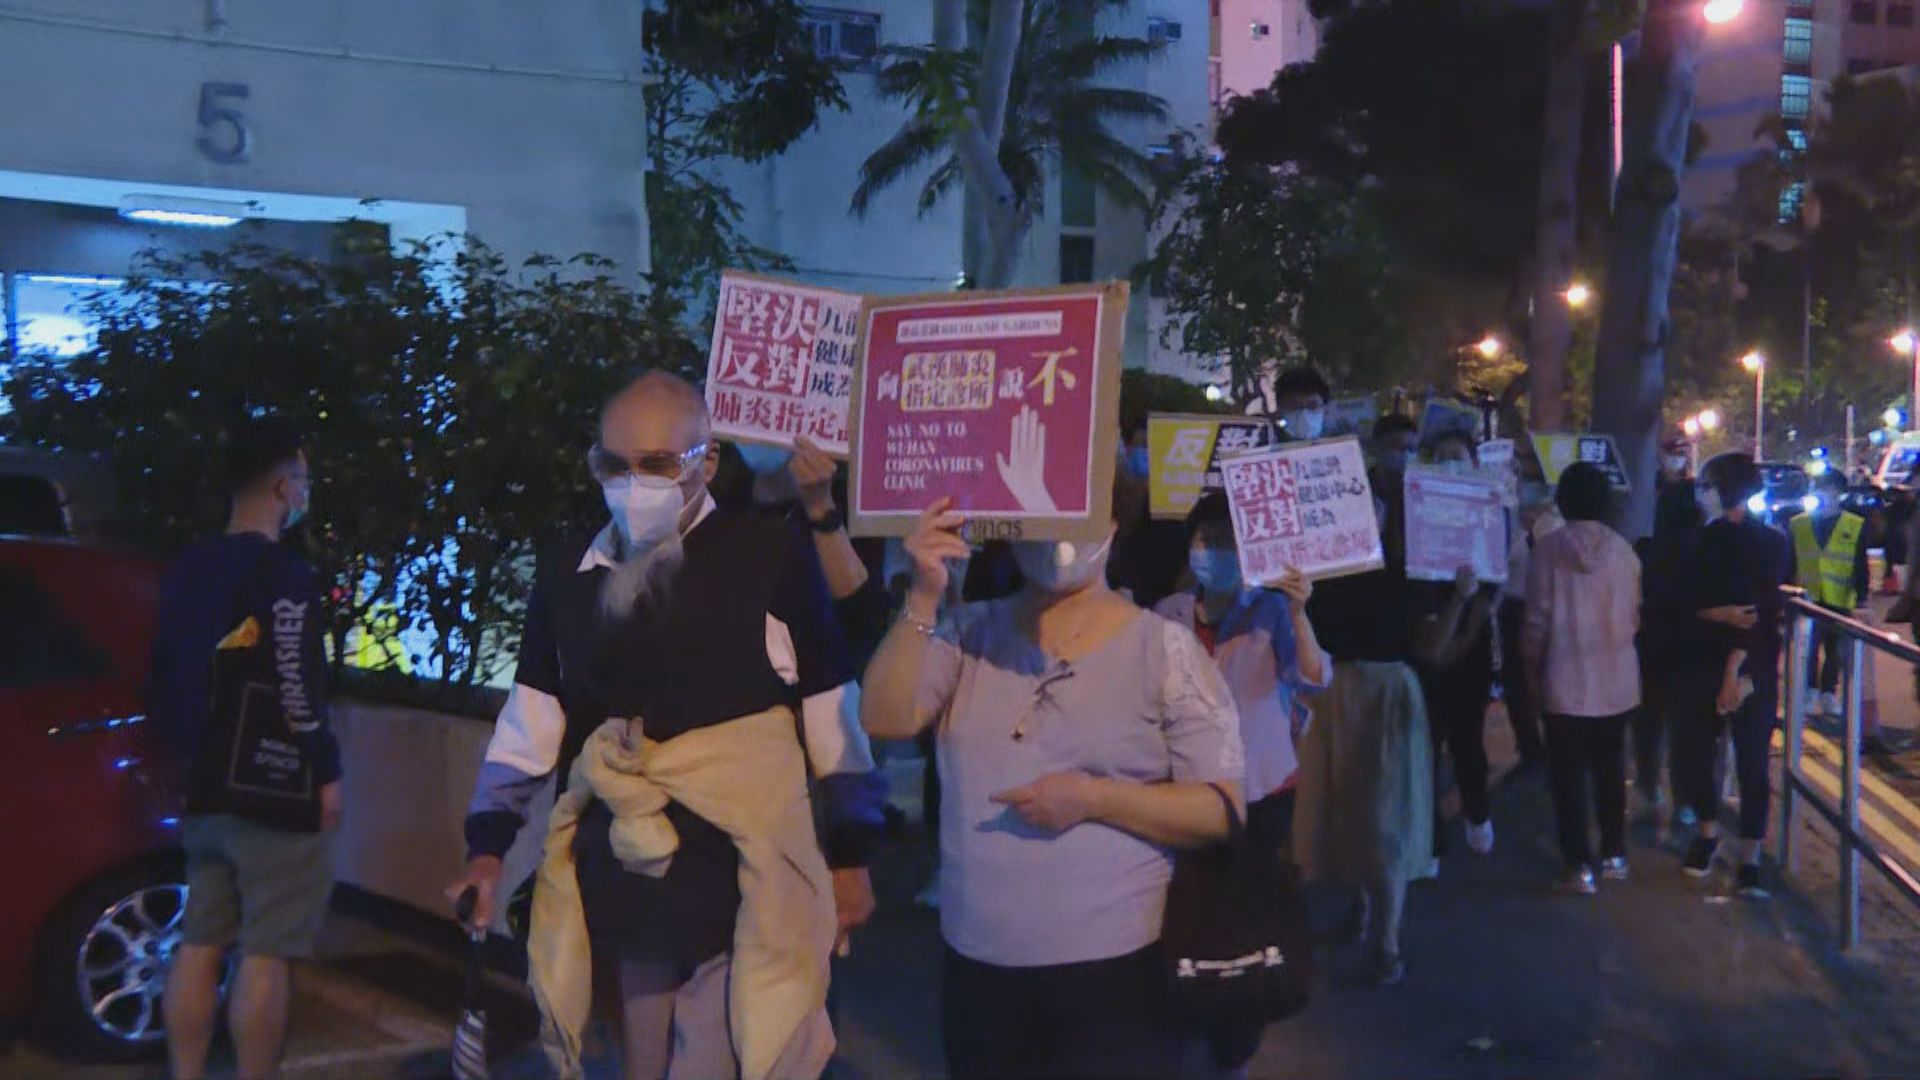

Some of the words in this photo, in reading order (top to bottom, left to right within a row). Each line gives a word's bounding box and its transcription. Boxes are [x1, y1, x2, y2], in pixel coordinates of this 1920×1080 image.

[194, 81, 249, 165] 5
[724, 285, 820, 345] 堅決
[716, 336, 813, 397] 反對
[906, 351, 991, 381] 武漢肺炎
[1025, 346, 1078, 407] 不
[886, 440, 936, 456] WUHAN
[887, 423, 912, 438] SAY
[919, 422, 940, 438] NO
[946, 421, 967, 437] TO
[883, 473, 925, 491] CLINIC
[884, 456, 984, 473] CORONAVIRUS
[1227, 458, 1298, 502] 堅決
[1239, 499, 1303, 542] 反對
